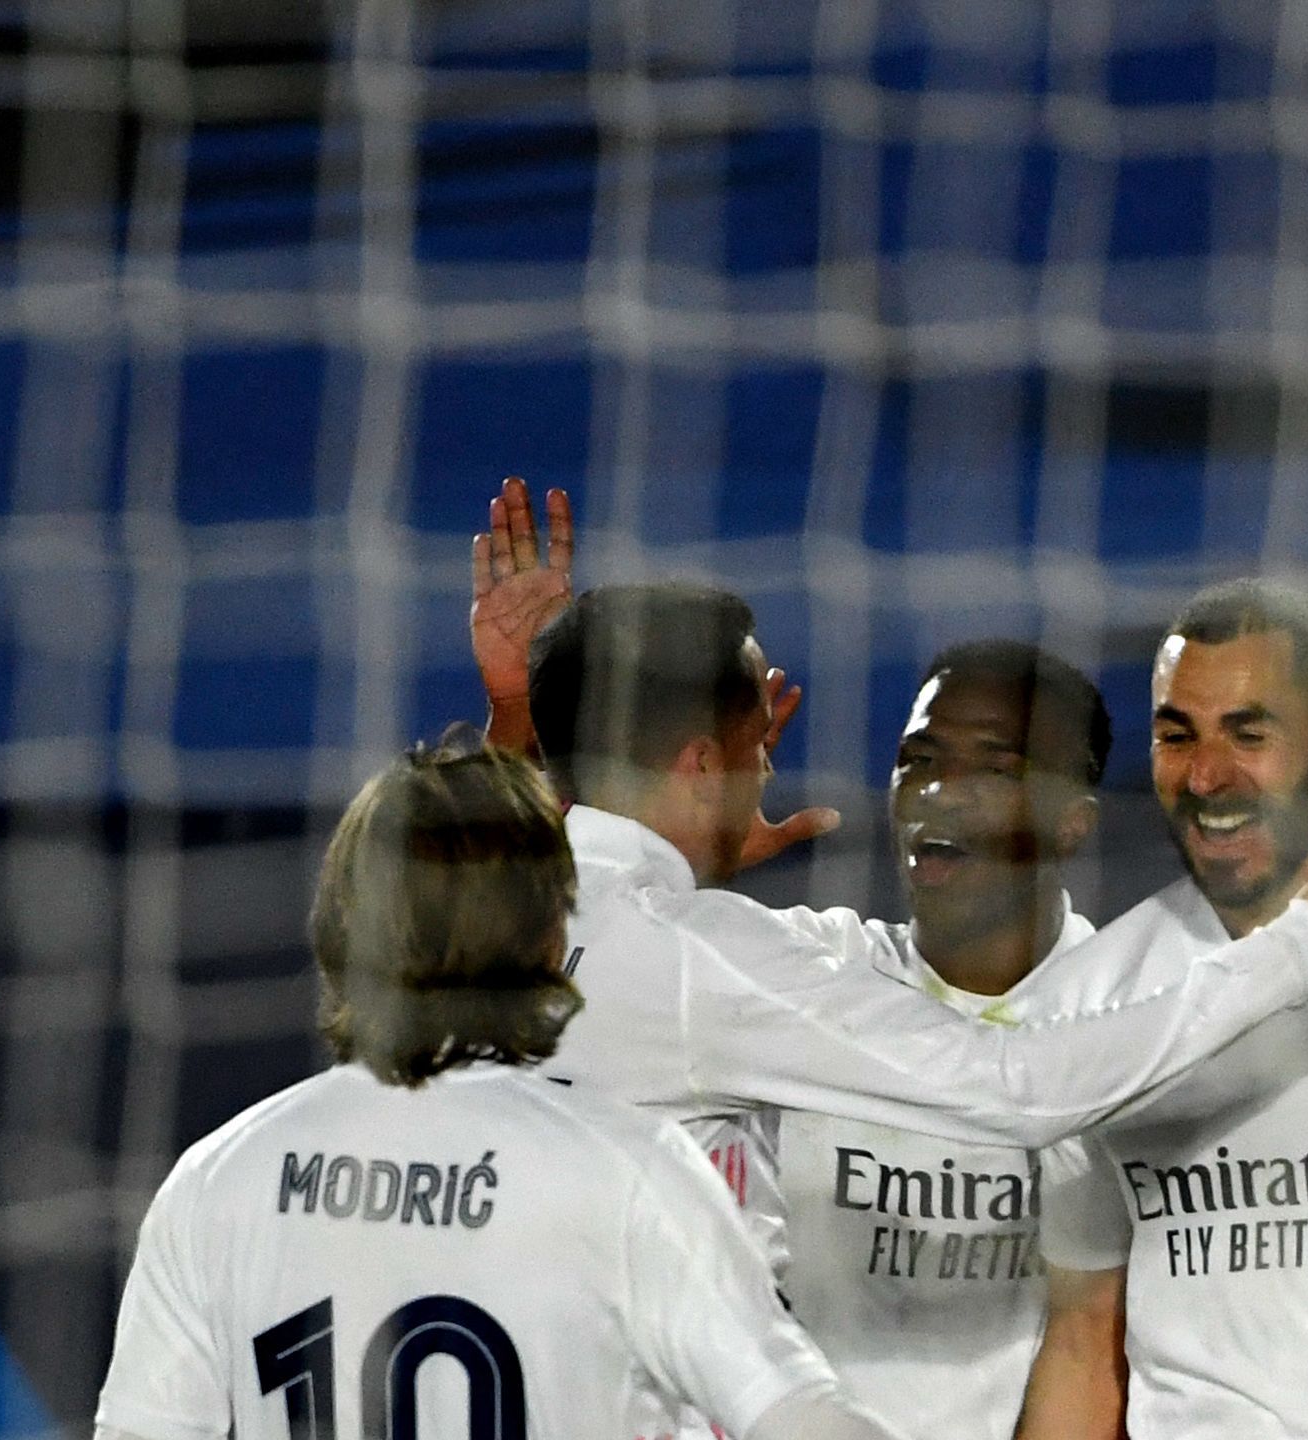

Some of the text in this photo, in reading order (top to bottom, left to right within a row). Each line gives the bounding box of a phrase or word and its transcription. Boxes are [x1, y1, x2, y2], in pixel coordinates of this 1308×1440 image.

[278, 1150, 498, 1229] MODRIĆ
[868, 1226, 928, 1278] FLY
[1166, 1226, 1214, 1277] FLY
